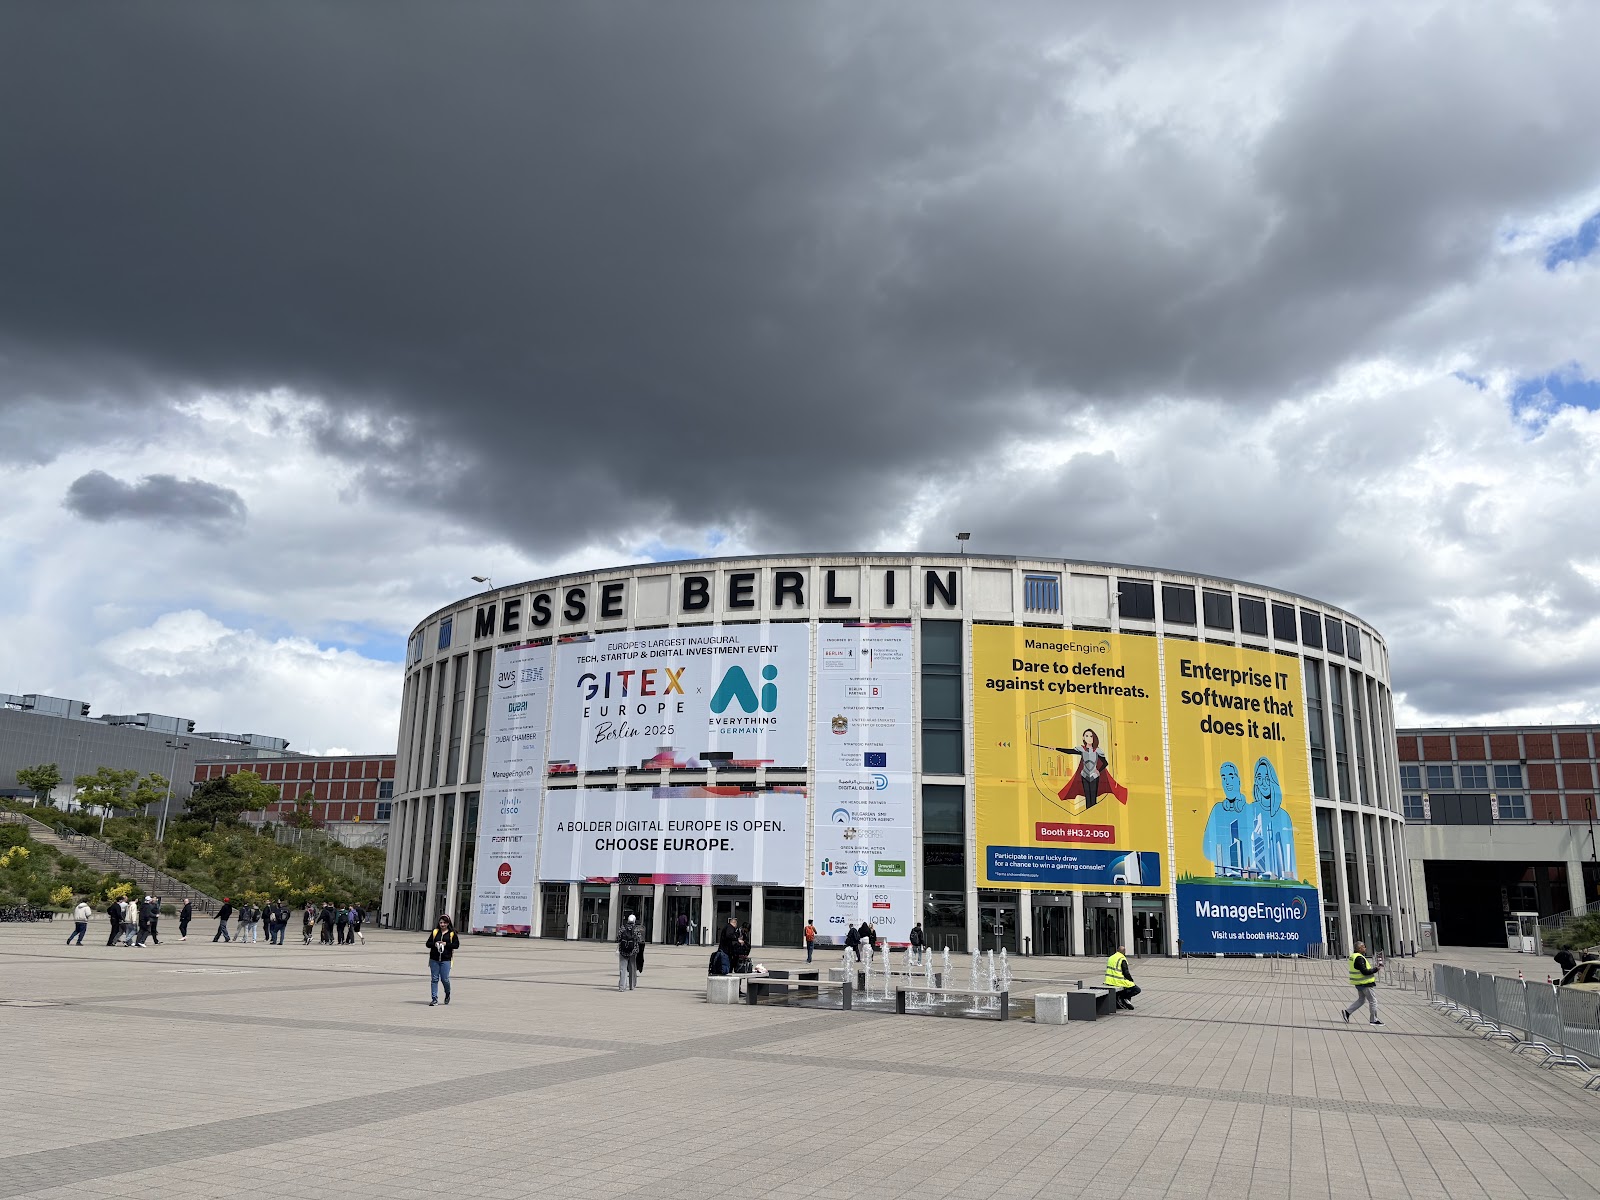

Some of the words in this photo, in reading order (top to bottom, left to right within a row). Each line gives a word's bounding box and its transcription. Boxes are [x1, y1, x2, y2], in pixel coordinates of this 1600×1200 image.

[474, 583, 624, 640] MESSE
[682, 569, 957, 611] BERLIN
[607, 640, 647, 651] EUROPE'S
[648, 637, 686, 648] LARGEST
[688, 635, 740, 646] INAUGURAL
[1024, 639, 1106, 655] ManageEngine
[576, 655, 599, 664] TECH,
[601, 651, 639, 662] STARTUP
[640, 650, 648, 658] &
[650, 648, 684, 658] DIGITAL
[686, 645, 745, 656] INVESTMENT
[747, 645, 778, 654] EVENT
[498, 670, 516, 683] aws
[520, 667, 545, 683] IBM
[1012, 658, 1050, 673] Dare
[1052, 661, 1069, 675] to
[1072, 662, 1126, 678] defend
[1180, 658, 1272, 688] Enterprise
[1274, 671, 1288, 691] IT
[576, 666, 686, 701] GITEX
[872, 687, 879, 696] B
[985, 676, 1045, 692] against
[1047, 679, 1149, 699] cyberthreats.
[583, 701, 684, 718] EUROPE
[1181, 687, 1261, 713] software
[1263, 695, 1294, 718] that
[708, 717, 777, 725] EVERYTHING
[1200, 714, 1245, 737] does
[1247, 718, 1260, 739] it
[1262, 721, 1286, 742] all.
[594, 721, 640, 744] Berlin
[644, 724, 675, 736] 2025
[492, 768, 532, 779] ManageEngine
[557, 822, 564, 832] A
[567, 821, 612, 832] BOLDER
[615, 820, 664, 832] DIGITAL
[668, 820, 722, 832] EUROPE
[726, 820, 738, 832] IS
[743, 820, 786, 832] OPEN.
[1040, 827, 1066, 837] Booth
[1067, 829, 1110, 839] #H3.2-D50
[594, 838, 659, 851] CHOOSE
[663, 838, 734, 851] EUROPE.
[994, 852, 1028, 862] Participate
[1045, 854, 1062, 863] lucky
[1056, 863, 1079, 871] gaming
[1195, 900, 1301, 923] ManageEngine
[829, 916, 846, 924] CSA
[1211, 930, 1228, 940] Visit
[1237, 932, 1245, 940] at
[1245, 931, 1266, 940] booth
[1266, 931, 1300, 941] #H3.2-D50
